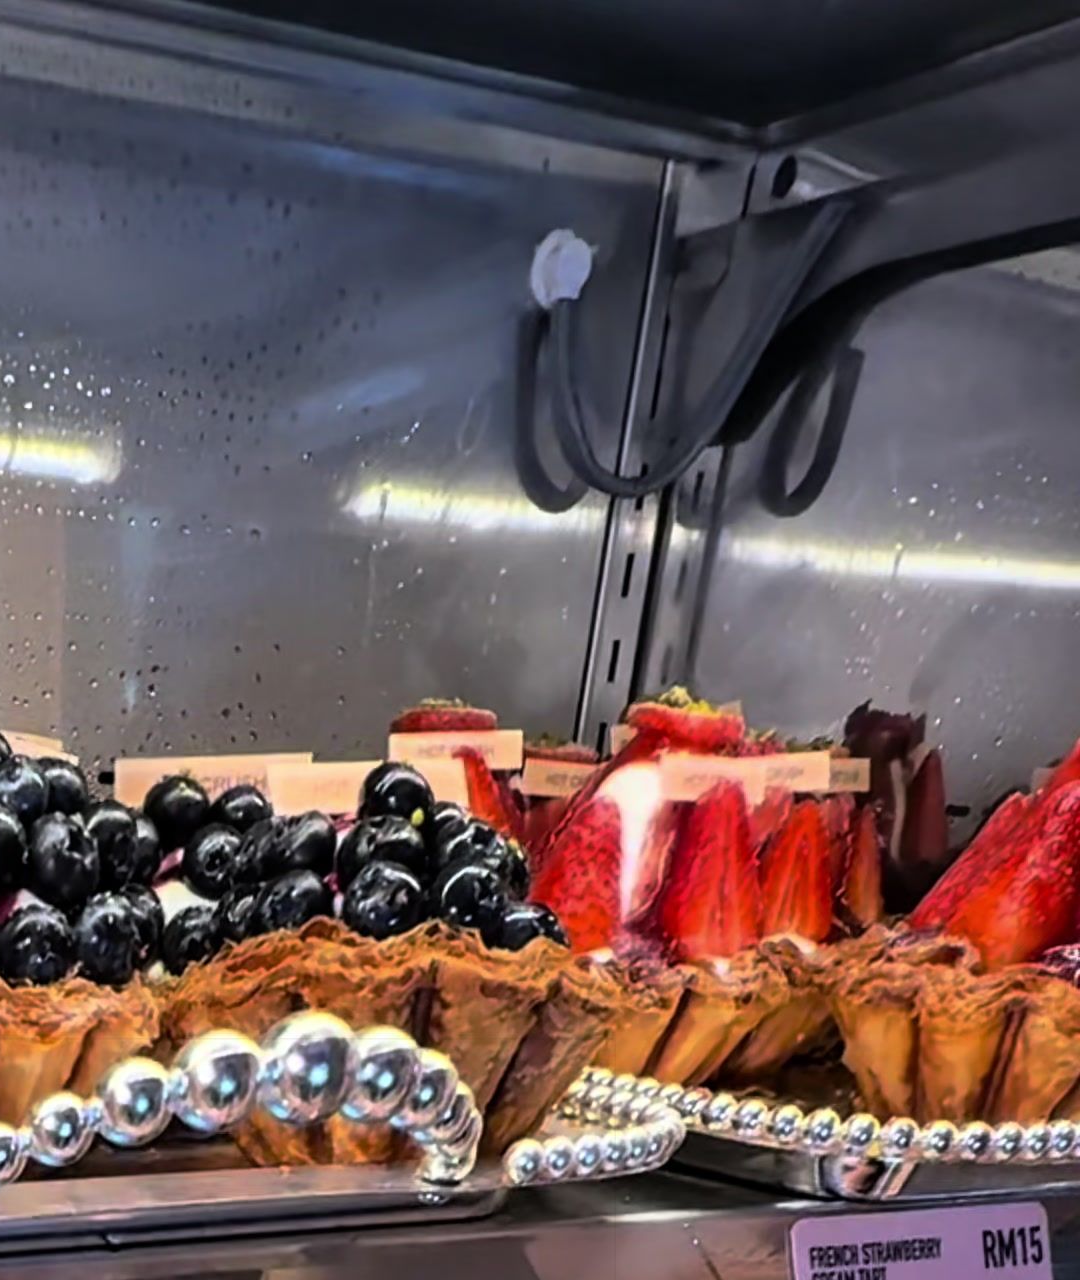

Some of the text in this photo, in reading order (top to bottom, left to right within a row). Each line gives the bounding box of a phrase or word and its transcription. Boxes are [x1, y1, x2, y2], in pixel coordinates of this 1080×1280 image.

[810, 1227, 1043, 1269] FRENCH STRAWBERRY RM15
